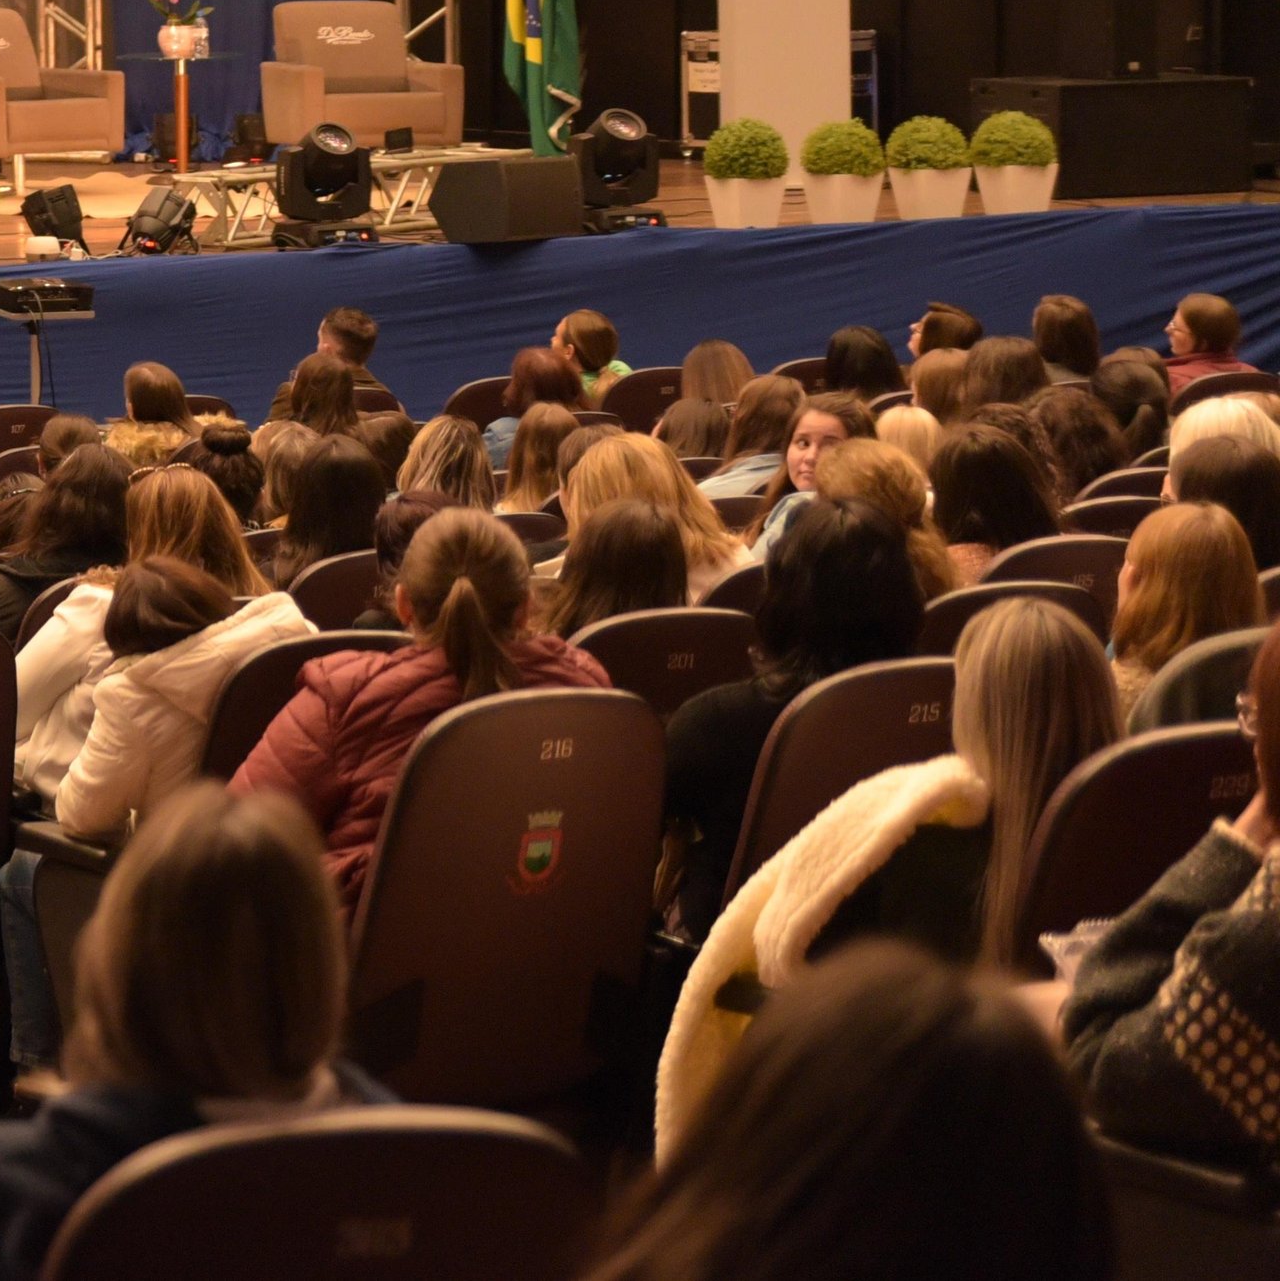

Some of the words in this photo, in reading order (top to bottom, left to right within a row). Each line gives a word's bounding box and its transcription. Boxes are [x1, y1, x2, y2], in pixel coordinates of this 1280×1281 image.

[667, 653, 695, 671] 201
[908, 703, 941, 725] 215
[540, 737, 574, 761] 216
